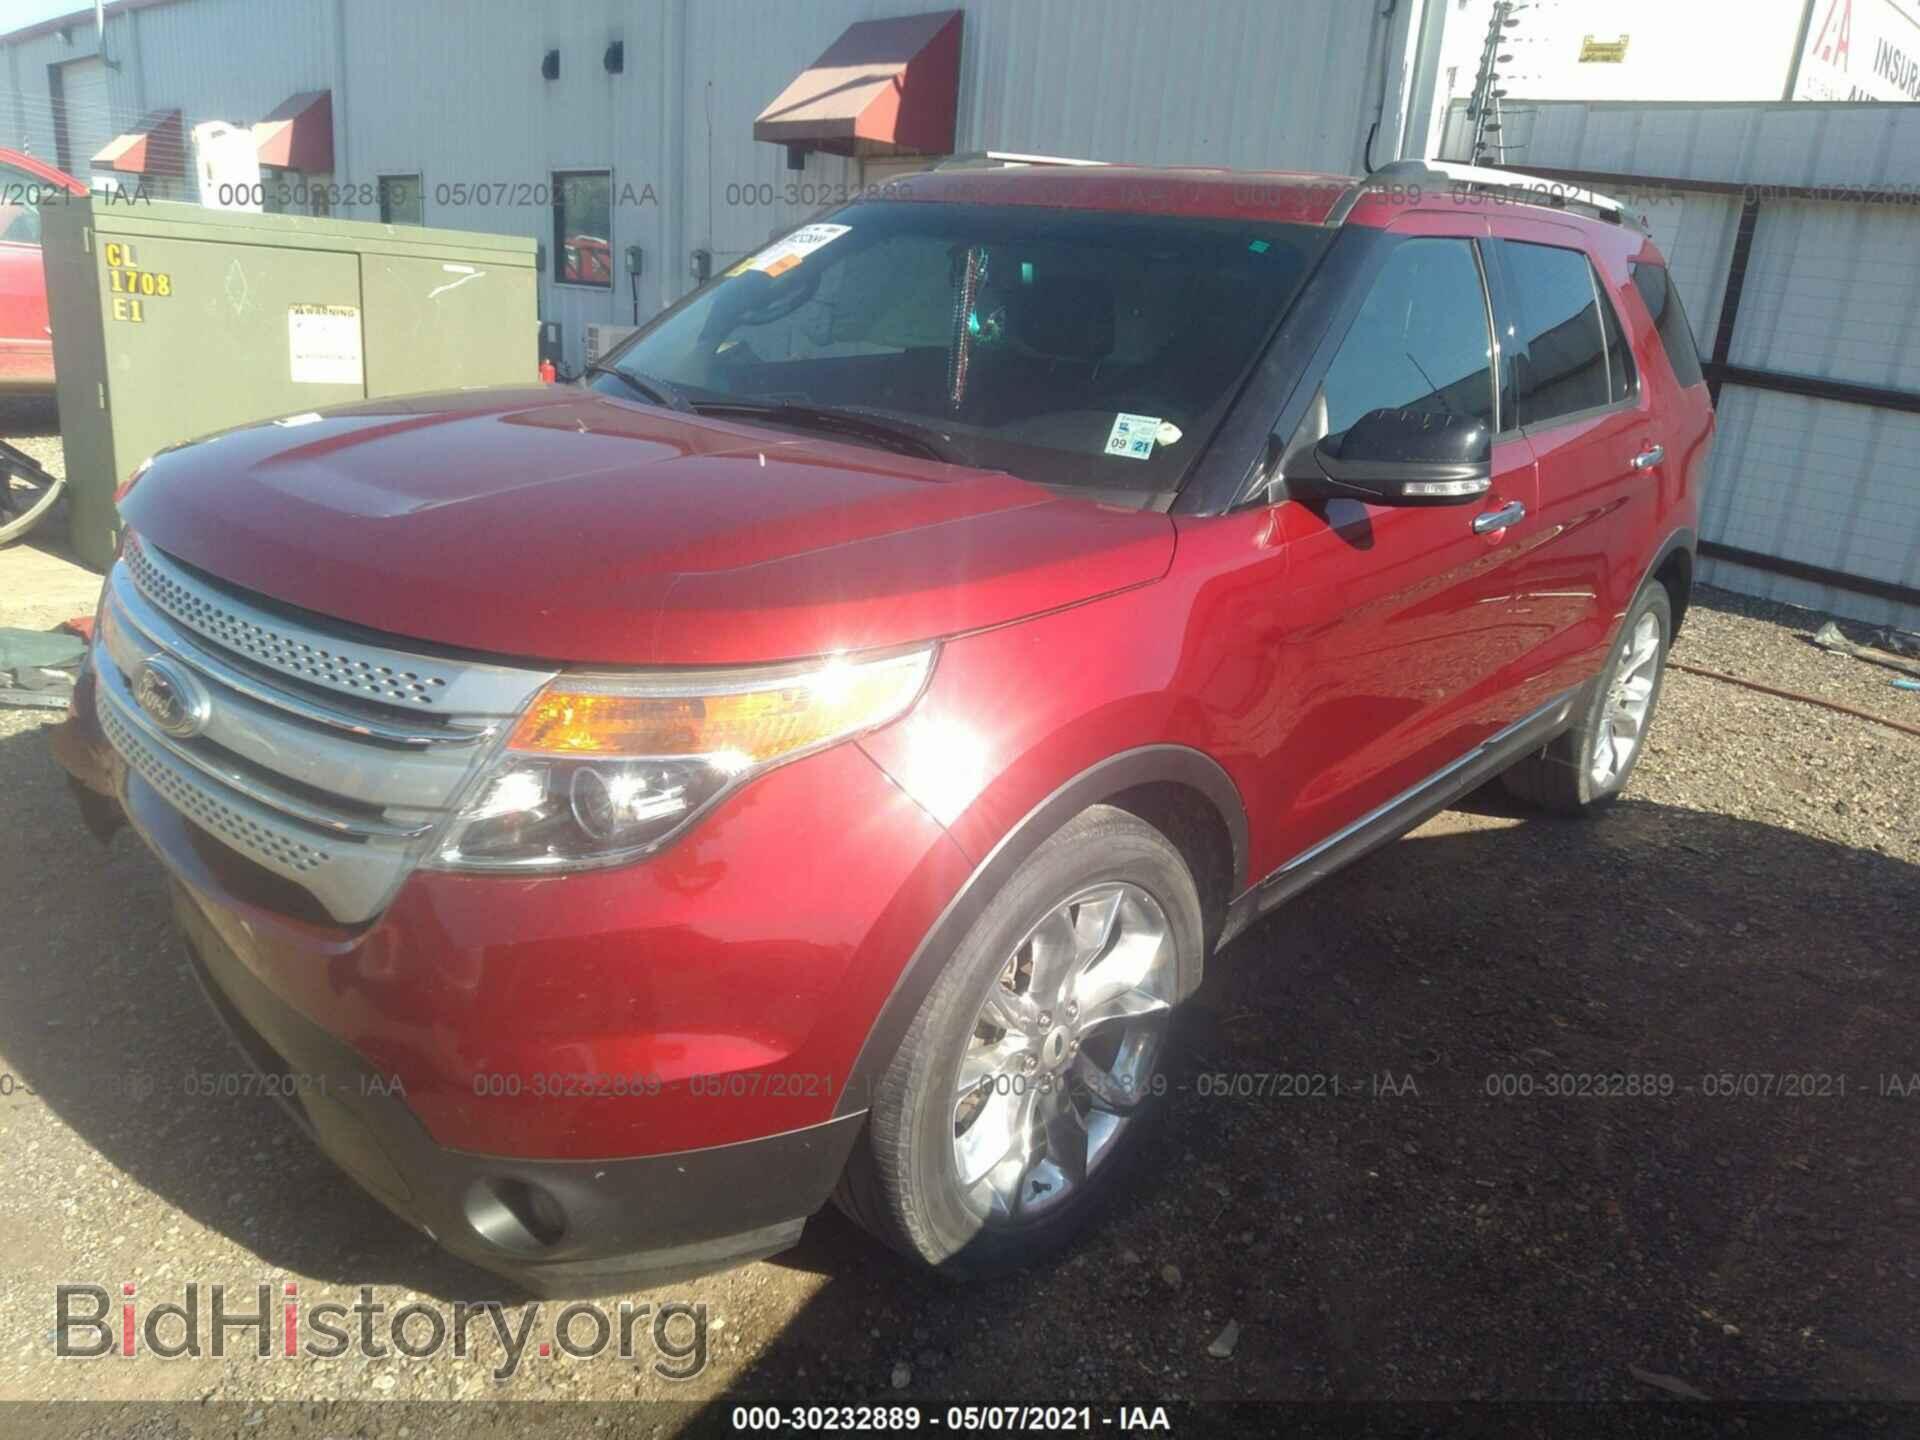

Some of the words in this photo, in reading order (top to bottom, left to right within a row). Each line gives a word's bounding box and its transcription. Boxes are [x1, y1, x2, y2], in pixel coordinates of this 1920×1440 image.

[106, 243, 137, 267] CL
[111, 270, 170, 296] 1708
[114, 298, 142, 322] E1
[1111, 438, 1127, 449] 09
[1135, 440, 1150, 453] 21
